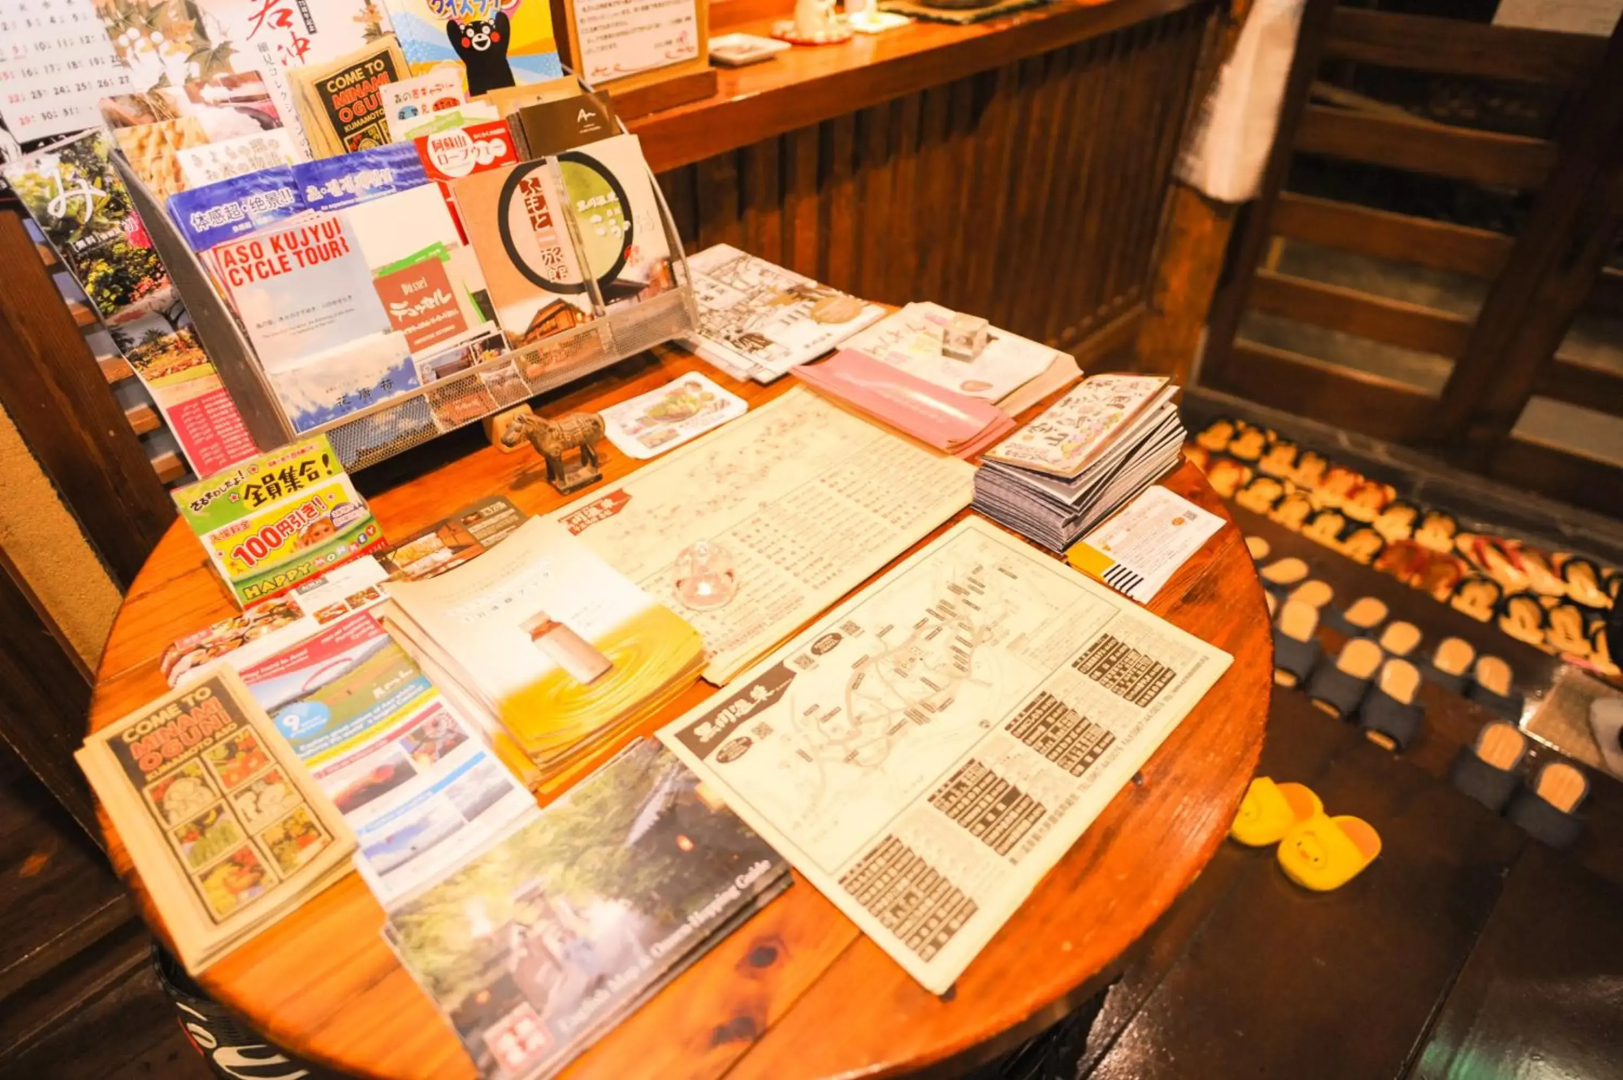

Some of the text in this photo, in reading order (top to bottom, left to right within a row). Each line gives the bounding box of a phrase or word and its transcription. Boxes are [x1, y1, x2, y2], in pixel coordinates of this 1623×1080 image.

[326, 58, 385, 93] COME TO
[332, 71, 391, 107] MINAMI
[221, 240, 264, 268] ASO
[227, 252, 292, 287] CYCLE
[243, 453, 333, 508] 全員集合!
[231, 496, 328, 567] 100円引き!
[243, 561, 312, 600] HAPPY
[121, 686, 212, 744] COME TO
[129, 696, 224, 760] MINAMI
[281, 711, 303, 734] 9
[138, 709, 233, 773] OGUNI
[145, 722, 238, 781] KUMAMOTO ASO
